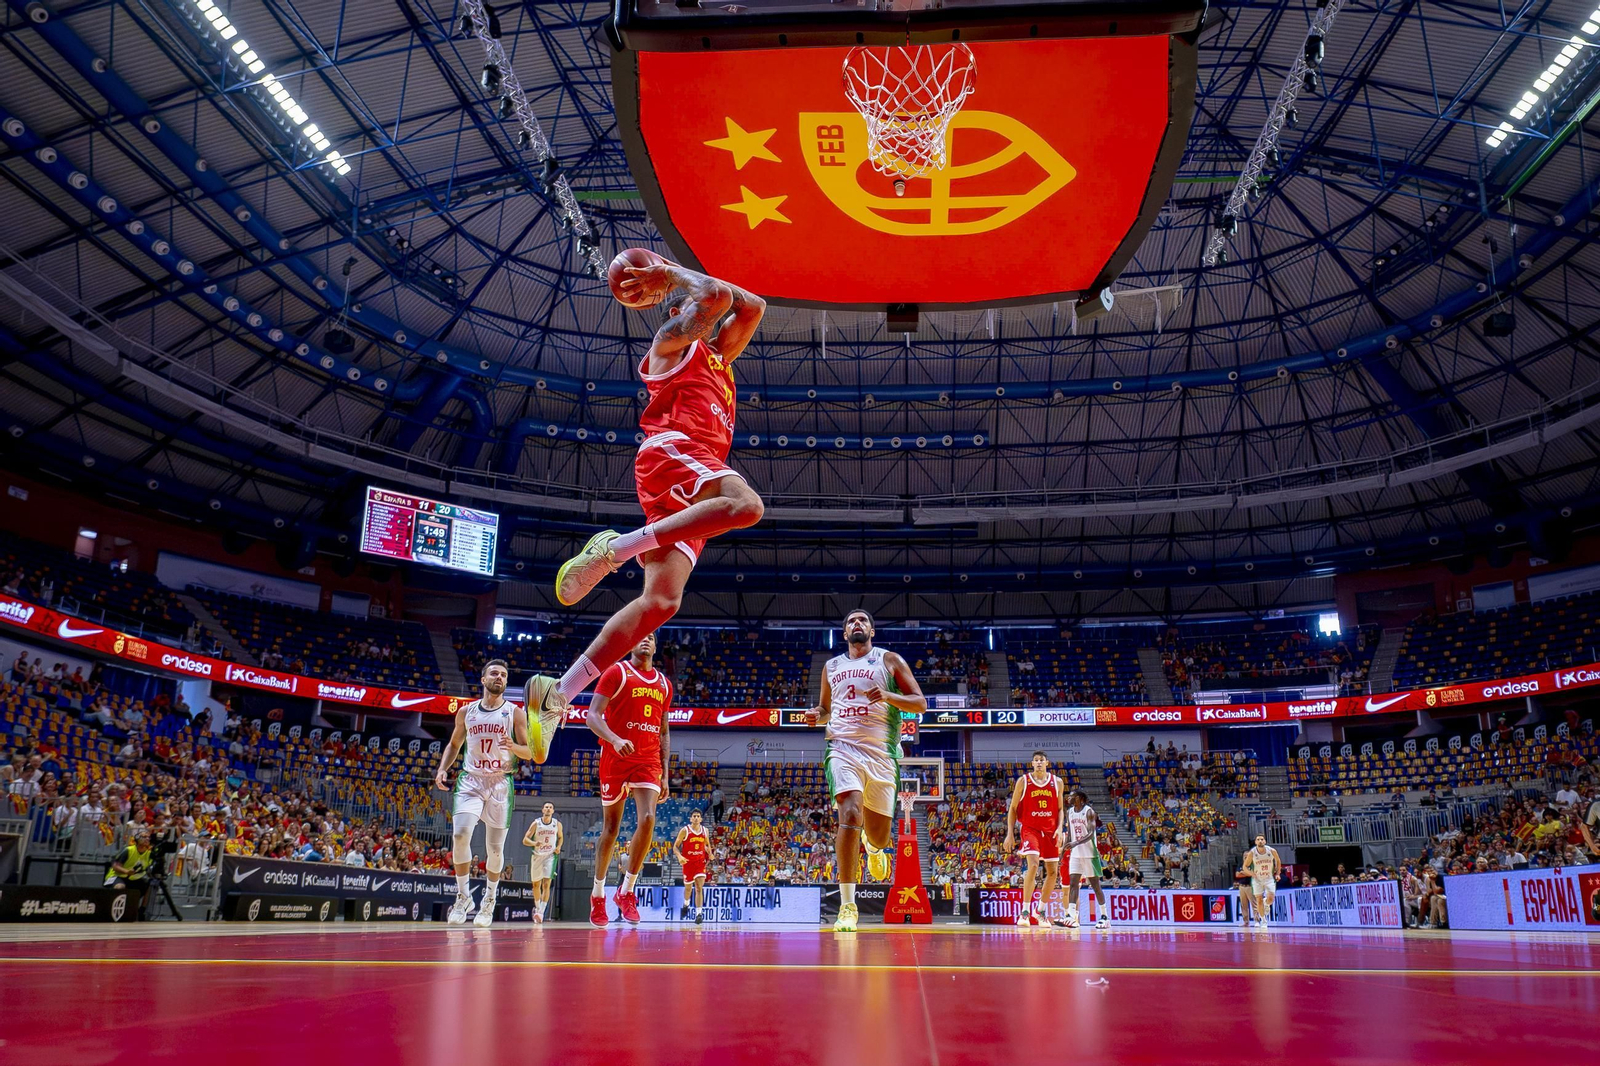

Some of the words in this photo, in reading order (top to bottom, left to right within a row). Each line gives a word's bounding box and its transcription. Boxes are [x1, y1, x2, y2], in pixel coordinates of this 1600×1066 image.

[816, 125, 846, 167] FEB
[418, 501, 430, 511] 11
[438, 505, 451, 515] 20
[423, 525, 445, 538] 1:49
[416, 545, 423, 553] 4
[438, 549, 444, 557] 3
[161, 654, 212, 675] endesa
[245, 672, 291, 690] CaixaBank
[832, 669, 876, 687] PORTUGAL
[632, 687, 664, 703] ESPAÑA
[847, 684, 855, 700] 3
[1483, 680, 1539, 698] endesa
[643, 704, 652, 717] 8
[997, 711, 1017, 723] 20
[1133, 709, 1182, 721] endesa
[1215, 708, 1261, 719] CaixaBank
[966, 711, 983, 724] 16
[1039, 713, 1089, 722] PORTUGAL
[626, 720, 660, 733] endesa
[901, 721, 916, 734] 23
[480, 739, 493, 753] 17
[1031, 789, 1052, 798] ESPAÑA
[1038, 800, 1047, 808] 16
[263, 869, 298, 885] endesa
[744, 887, 781, 908] AREA
[980, 891, 1042, 899] PARTIO
[1520, 867, 1581, 922] ESPAÑA
[20, 900, 96, 916] #LaFamilia
[891, 906, 925, 914] CaixaBank
[1110, 888, 1169, 920] ESPAÑA
[665, 908, 673, 920] 21
[686, 908, 713, 920] AGSTO
